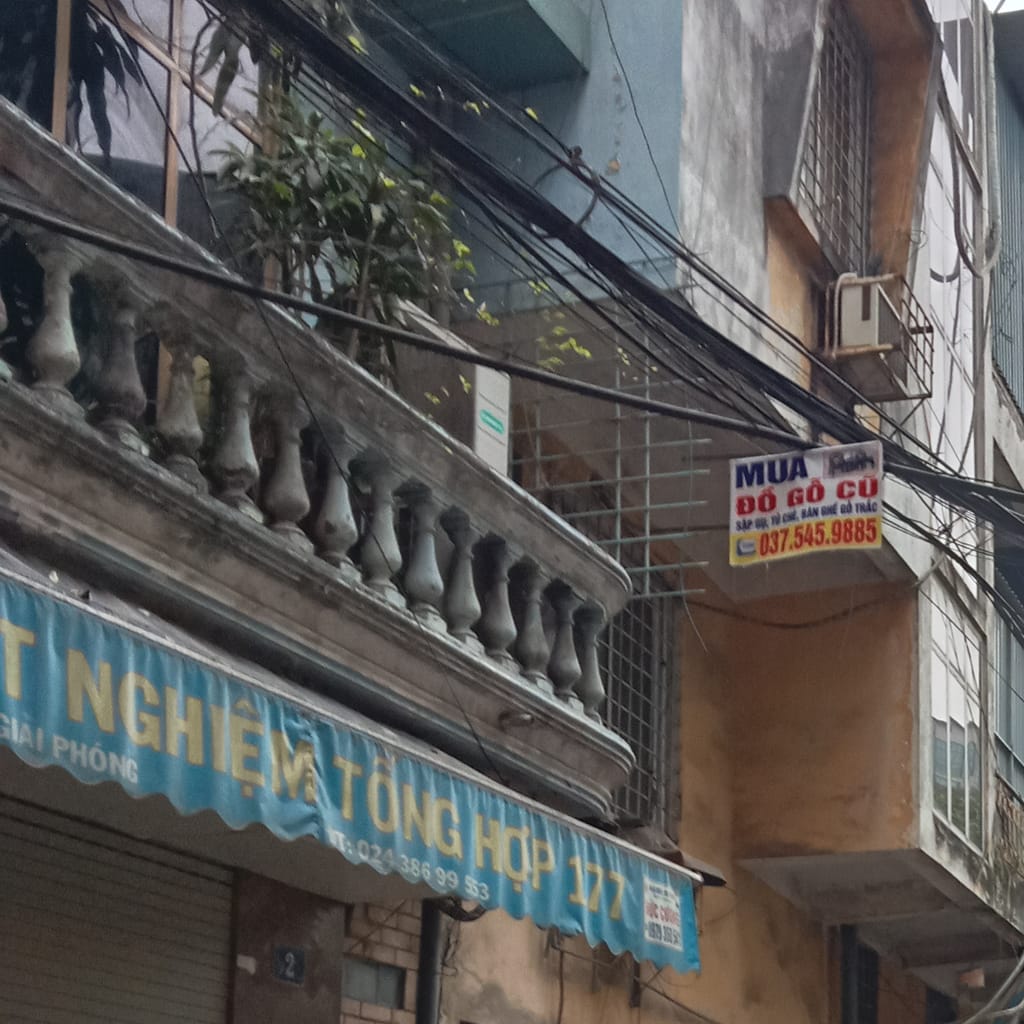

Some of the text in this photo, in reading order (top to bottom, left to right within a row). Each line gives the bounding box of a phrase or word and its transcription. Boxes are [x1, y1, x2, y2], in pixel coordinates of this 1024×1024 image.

[735, 456, 808, 488] MUA
[836, 474, 878, 499] CŨ
[760, 517, 877, 556] 037.545.9885
[52, 733, 139, 784] PHÓNG
[66, 648, 317, 804] NGHIỆM
[332, 755, 463, 860] TỔNG
[475, 814, 556, 893] HỢP
[568, 856, 625, 920] 177
[357, 839, 394, 867] 024
[400, 854, 431, 880] 386
[436, 867, 458, 889] 99
[285, 951, 295, 978] 2
